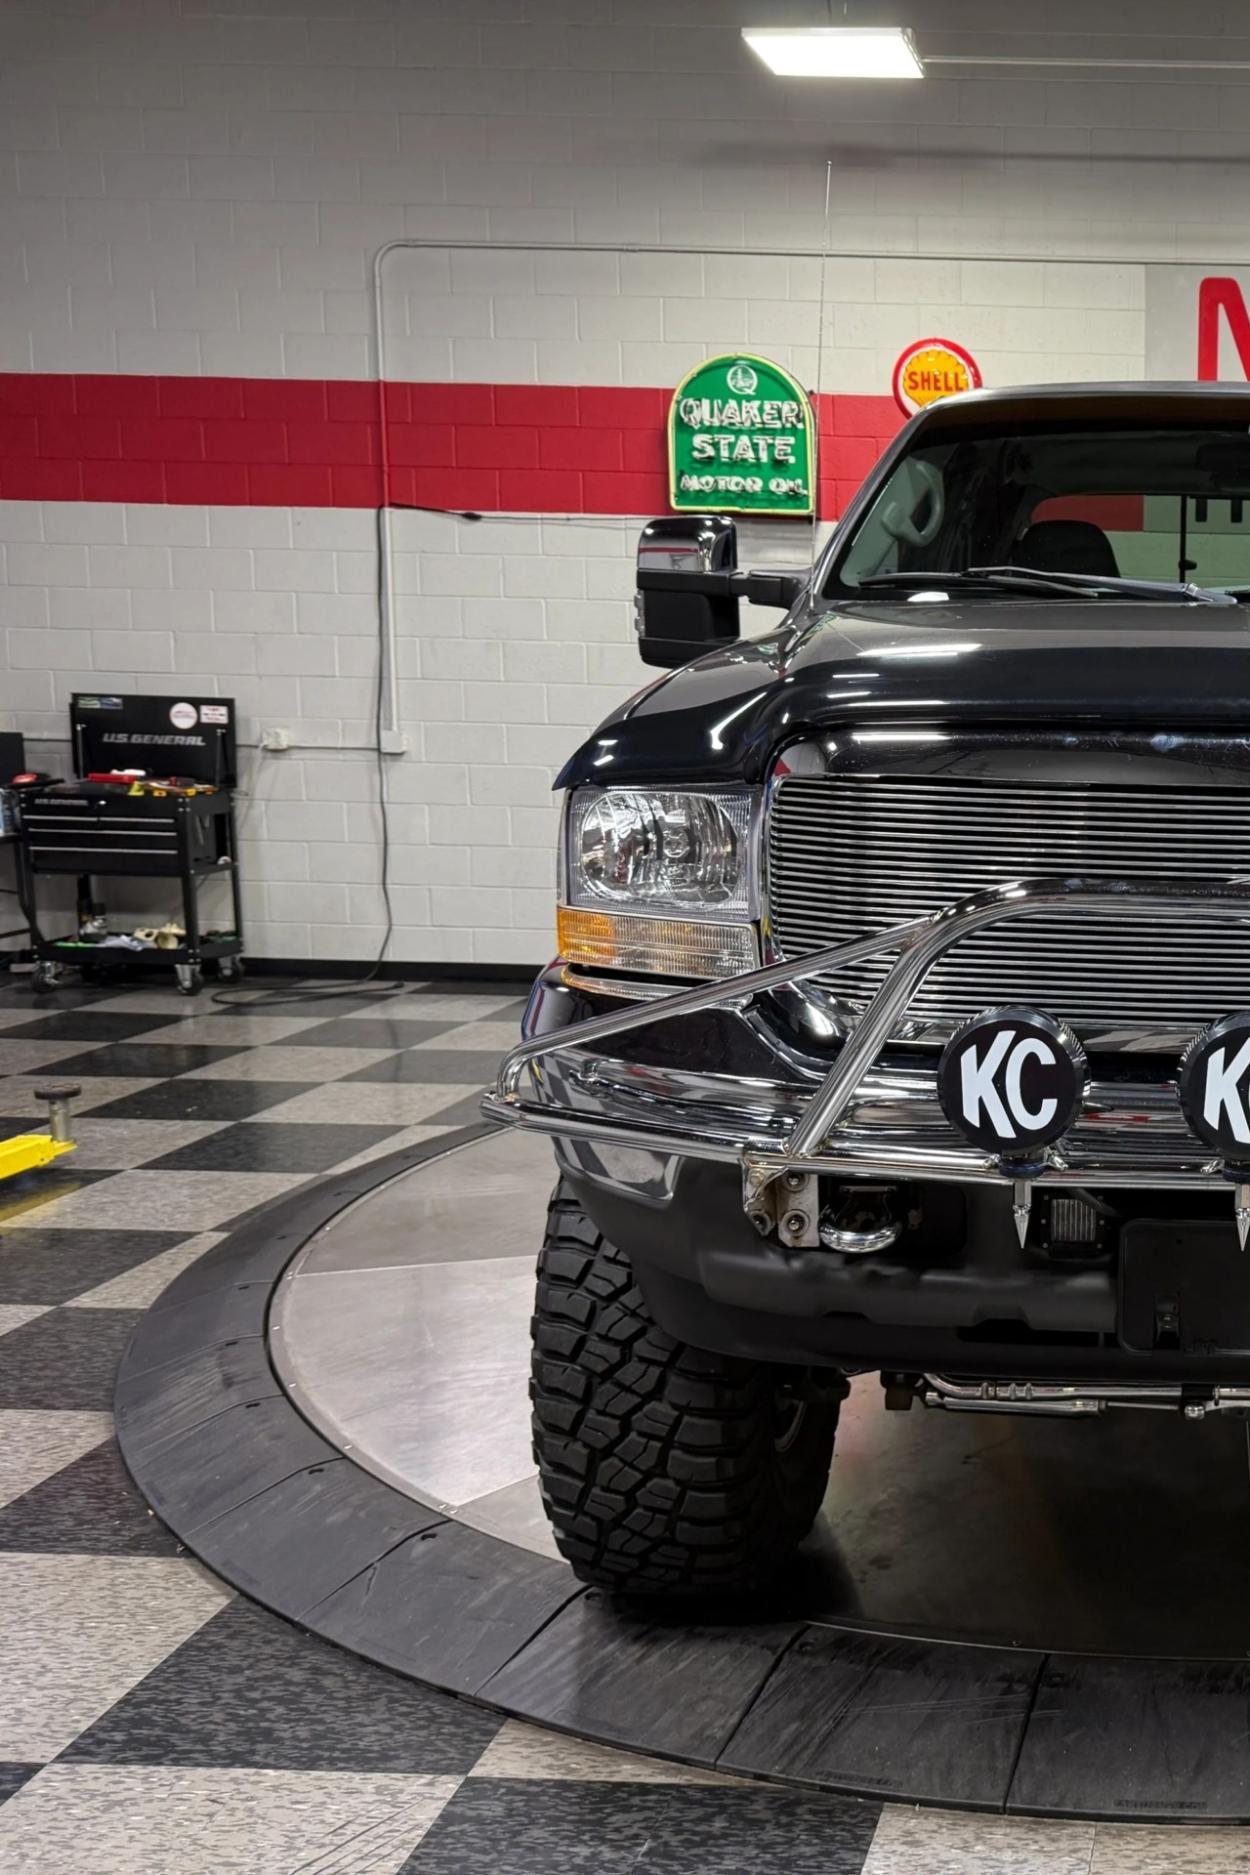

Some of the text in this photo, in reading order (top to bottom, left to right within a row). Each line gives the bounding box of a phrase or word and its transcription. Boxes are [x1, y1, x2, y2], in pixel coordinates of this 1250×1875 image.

[906, 371, 965, 392] SHELL
[680, 398, 804, 430] QUAKER
[691, 433, 796, 464] STATE
[680, 474, 808, 496] MOTOR OIL
[130, 734, 206, 746] GENERAL
[960, 1030, 1059, 1139] KC
